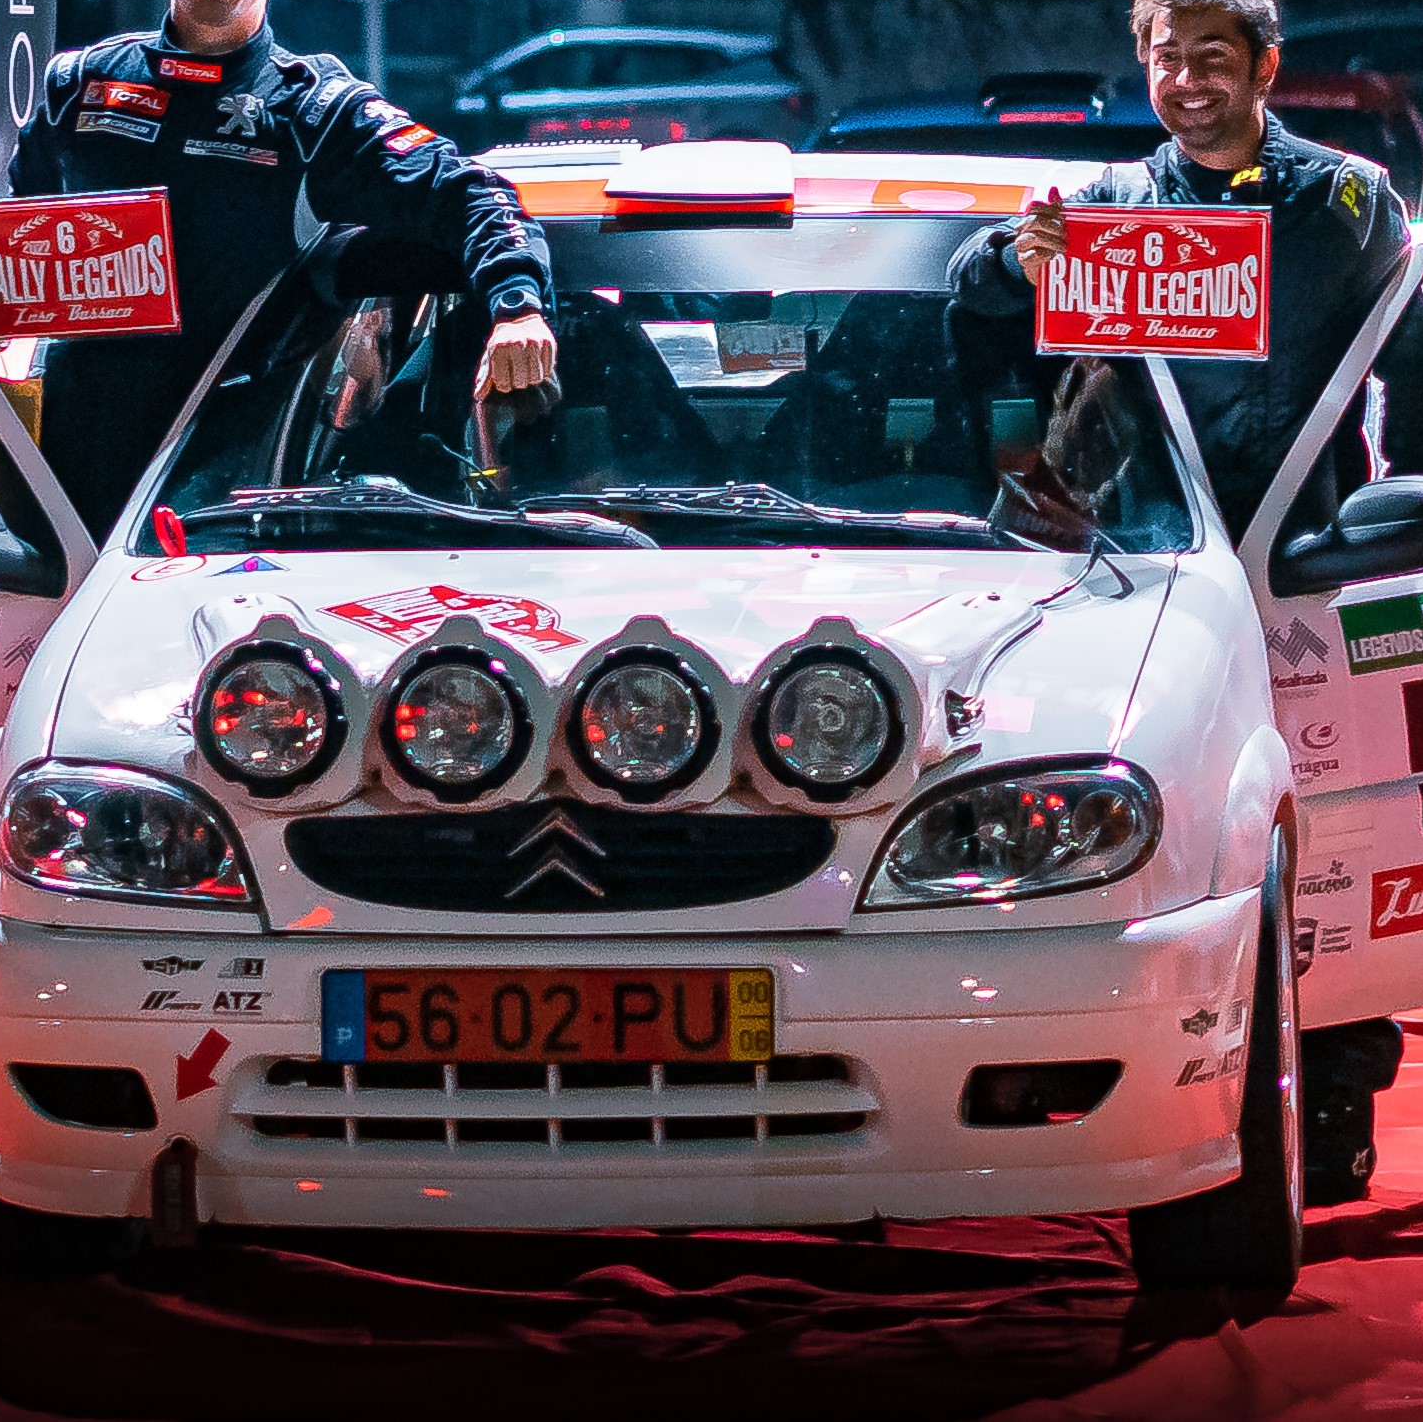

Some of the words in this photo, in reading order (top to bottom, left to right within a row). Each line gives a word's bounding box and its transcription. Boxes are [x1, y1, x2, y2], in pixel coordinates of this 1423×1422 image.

[177, 65, 218, 78] TOTAL
[109, 88, 163, 109] TOTAL
[185, 139, 248, 153] PEUGEOT
[56, 221, 76, 254] 6
[1105, 248, 1136, 266] 2022
[1143, 232, 1164, 266] 6
[55, 234, 166, 301] LEGENDS
[1048, 253, 1128, 315] RALLY
[1137, 254, 1258, 319] LEGENDS
[212, 990, 263, 1011] ATZ
